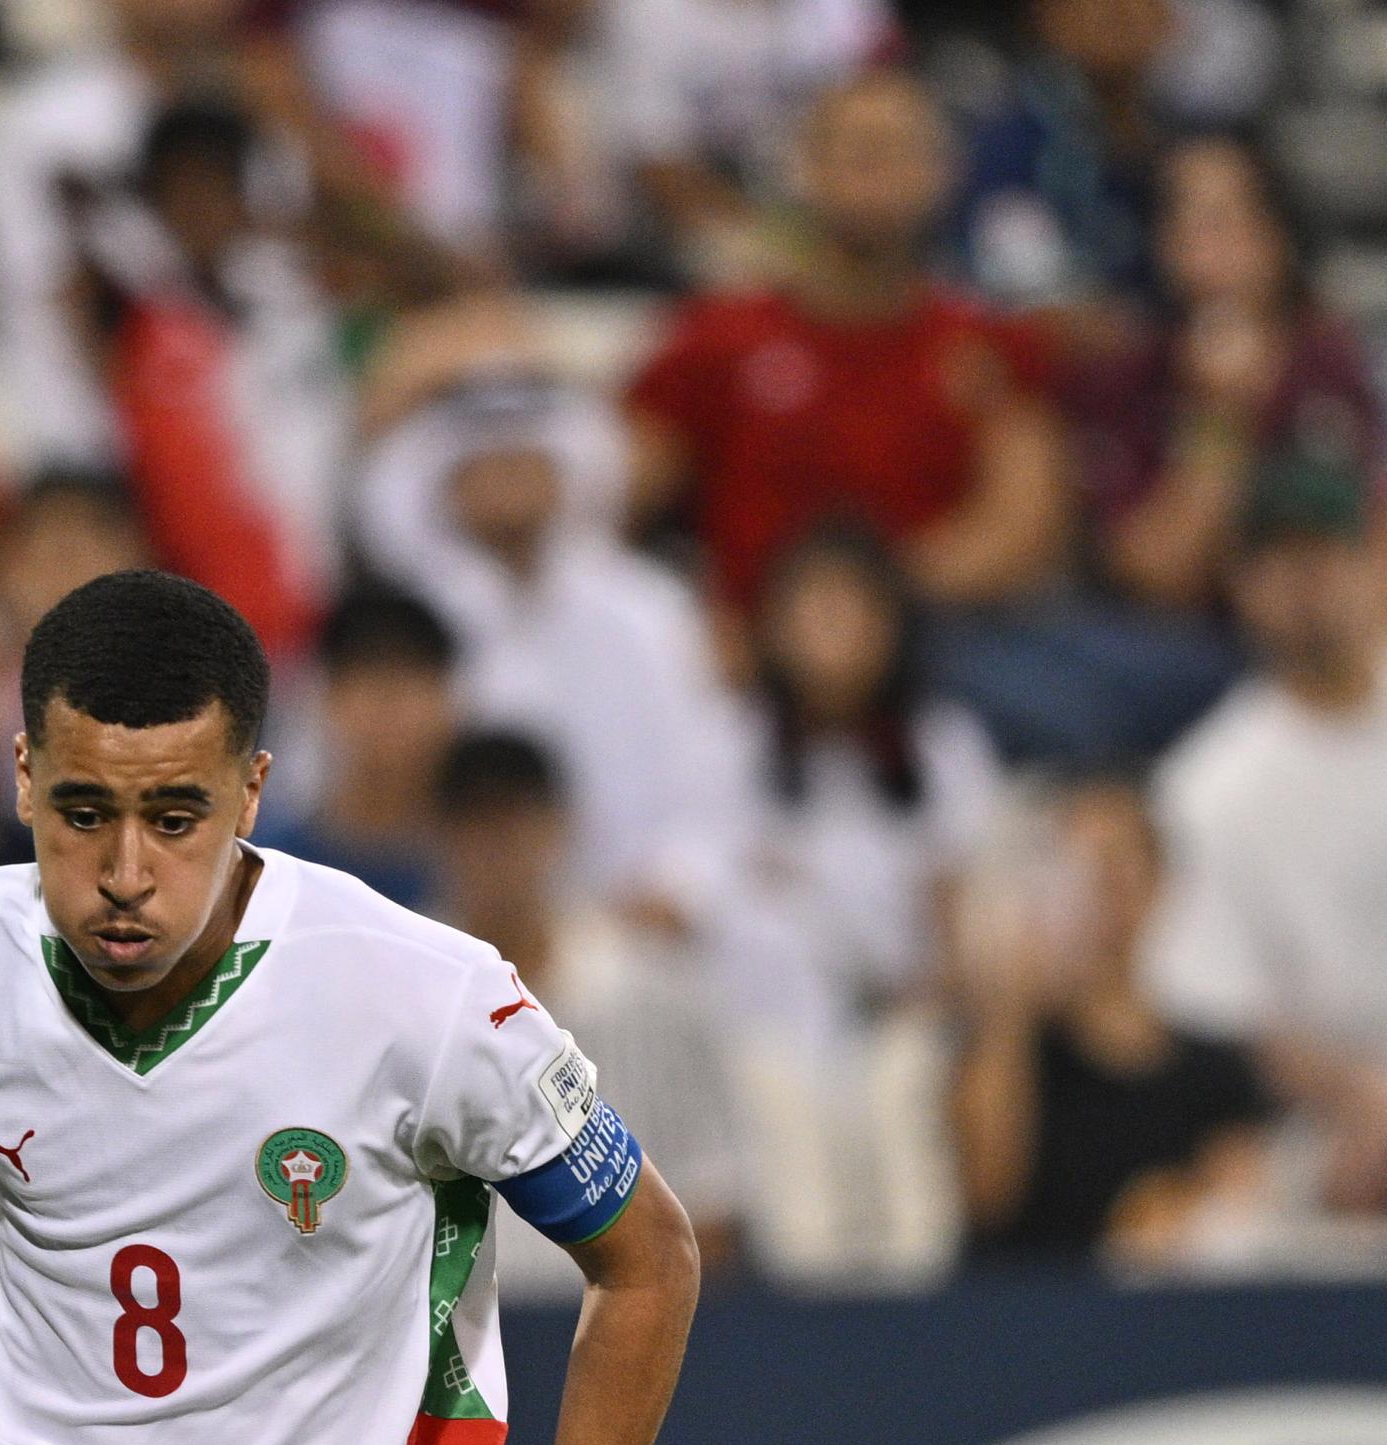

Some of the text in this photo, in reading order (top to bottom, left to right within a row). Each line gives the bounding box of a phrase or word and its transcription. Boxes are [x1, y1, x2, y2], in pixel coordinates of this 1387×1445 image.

[570, 1105, 616, 1184] UNITES
[581, 1174, 613, 1206] the
[617, 1159, 637, 1195] FIFA
[110, 1243, 188, 1398] 8
